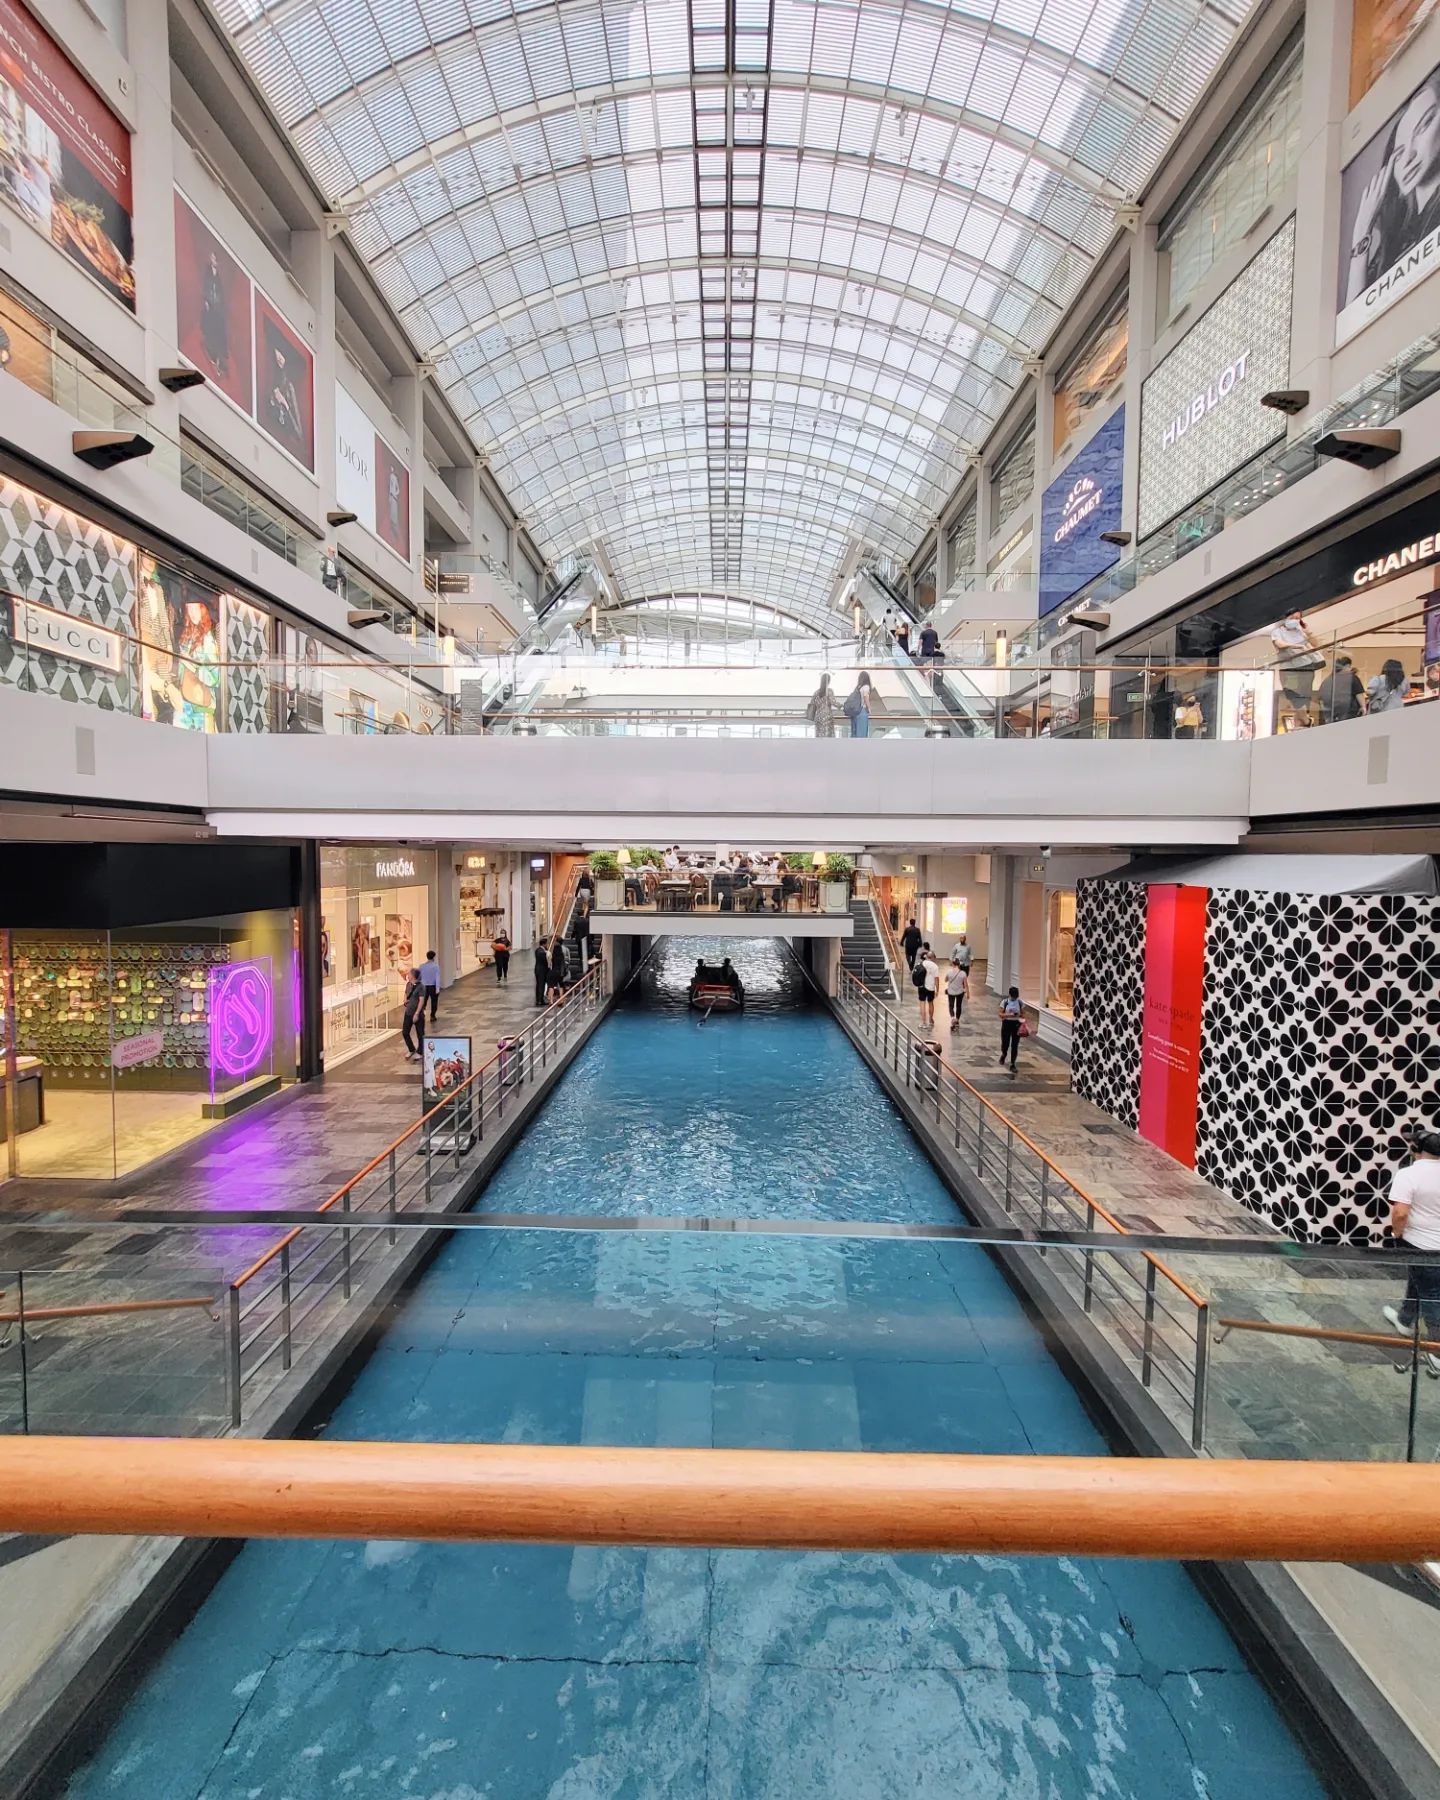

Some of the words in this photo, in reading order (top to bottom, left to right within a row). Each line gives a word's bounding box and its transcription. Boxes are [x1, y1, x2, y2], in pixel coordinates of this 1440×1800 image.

[31, 60, 75, 117] BISTRO
[77, 114, 127, 177] CLASSICS
[1365, 232, 1440, 307] CHANE
[1162, 348, 1251, 451] HUBLOT
[339, 435, 369, 481] DIOR
[1054, 488, 1103, 543] CHAUMET
[1057, 597, 1092, 627] CHMET
[24, 616, 110, 659] GUCCI
[375, 857, 416, 879] PANDORA
[1149, 996, 1168, 1013] kate
[120, 1046, 158, 1063] PROMOTION
[122, 1037, 156, 1053] SEASONAL
